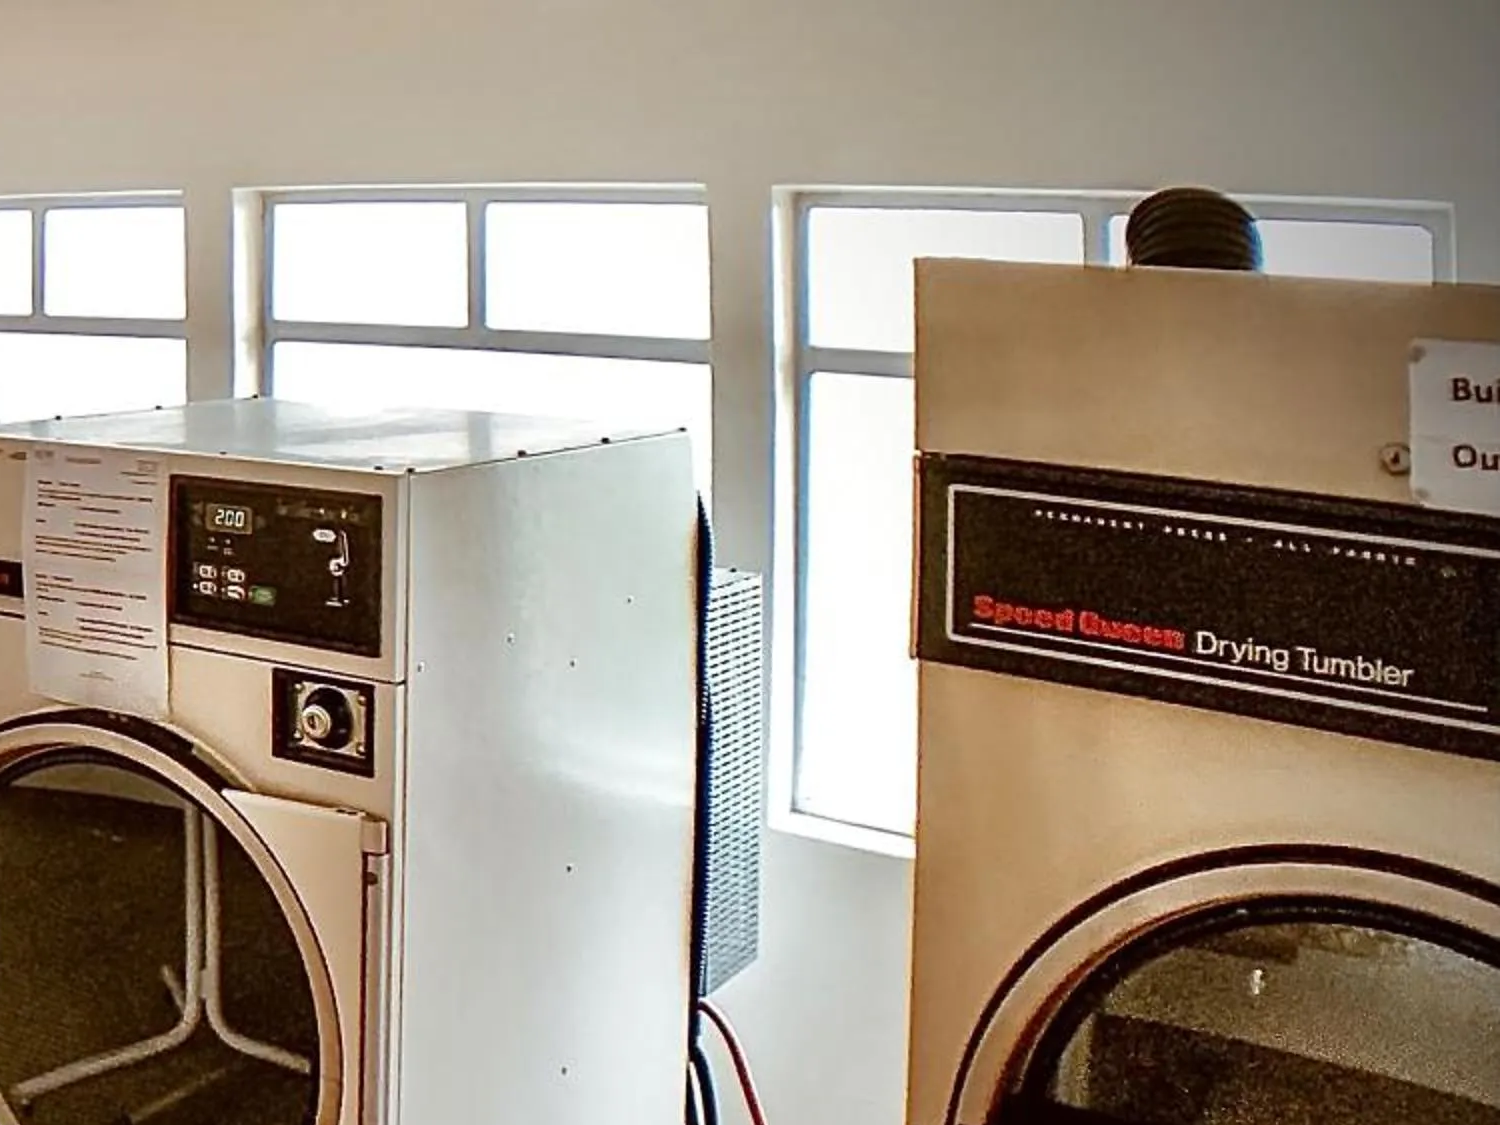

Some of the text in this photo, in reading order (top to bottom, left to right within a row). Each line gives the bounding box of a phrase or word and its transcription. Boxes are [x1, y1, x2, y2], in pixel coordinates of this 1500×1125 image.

[973, 594, 1415, 687] Speed Queen Drying Tumbler
